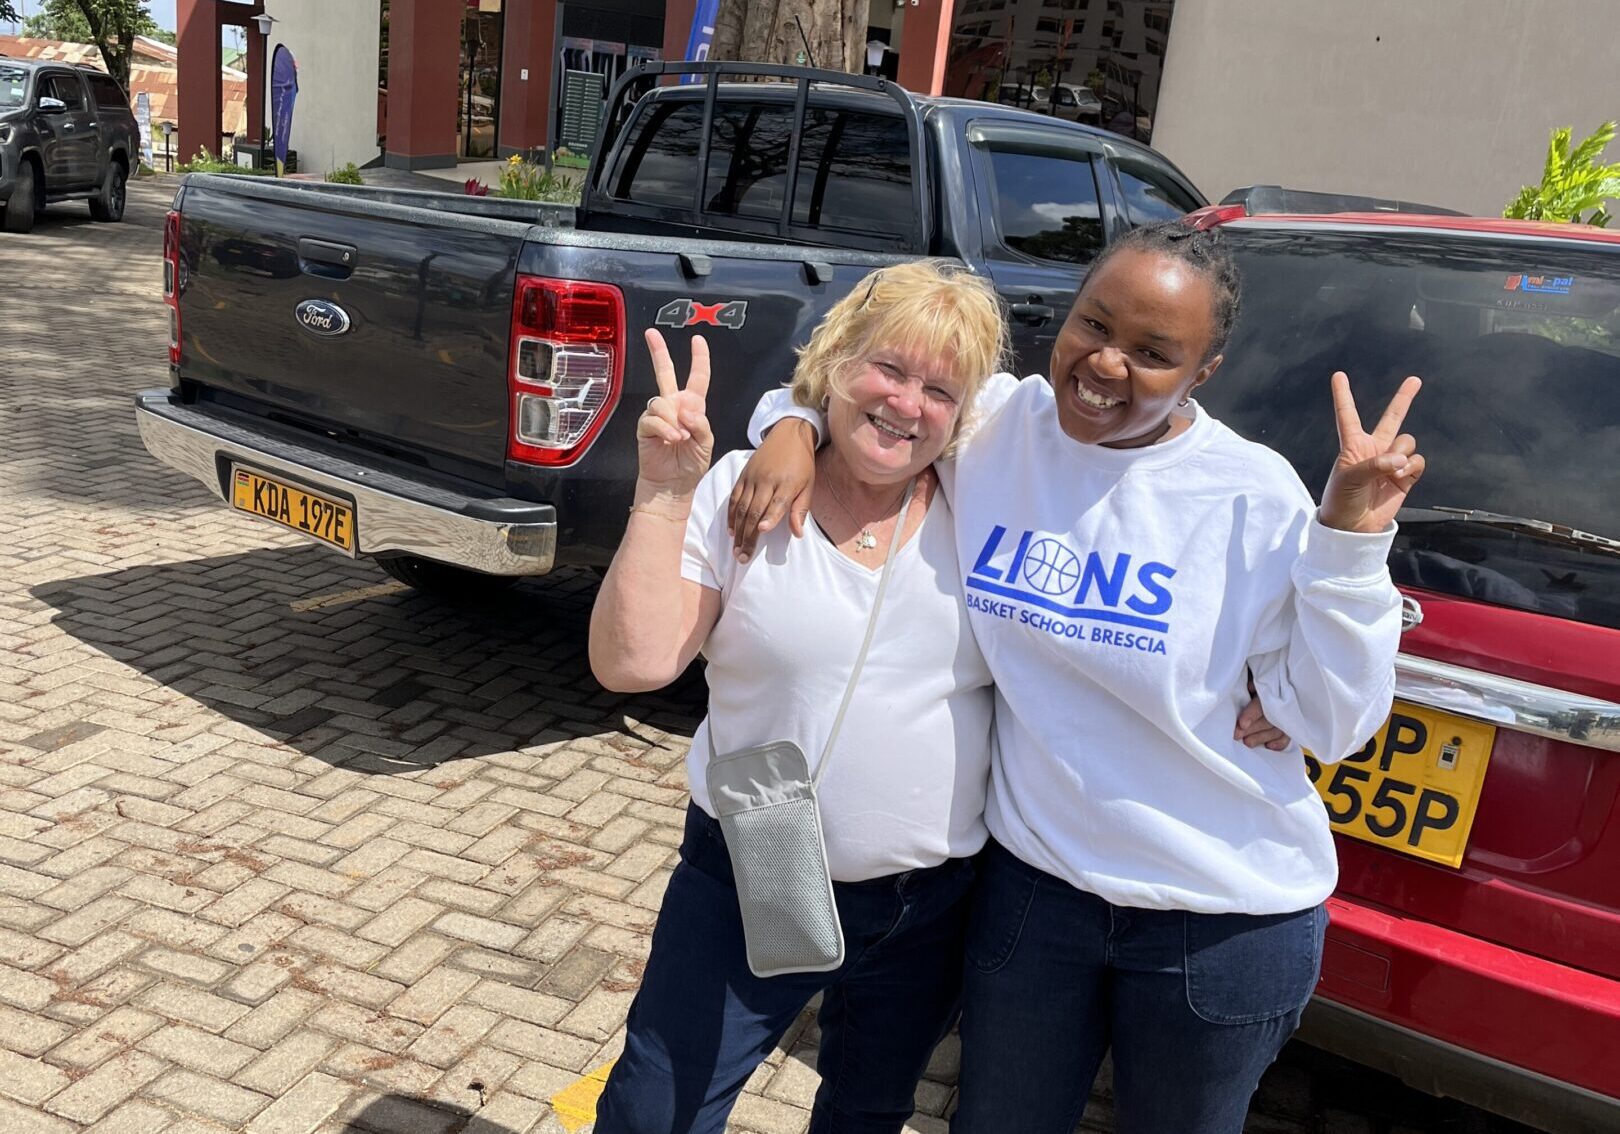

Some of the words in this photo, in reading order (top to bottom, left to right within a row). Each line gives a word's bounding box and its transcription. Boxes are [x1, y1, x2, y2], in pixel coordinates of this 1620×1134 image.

[303, 304, 334, 329] Ford
[253, 477, 291, 523] KDA
[298, 495, 346, 545] 197E
[966, 594, 1017, 620] BASKET
[1019, 609, 1086, 640] SCHOOL
[1090, 627, 1168, 656] BRESCIA
